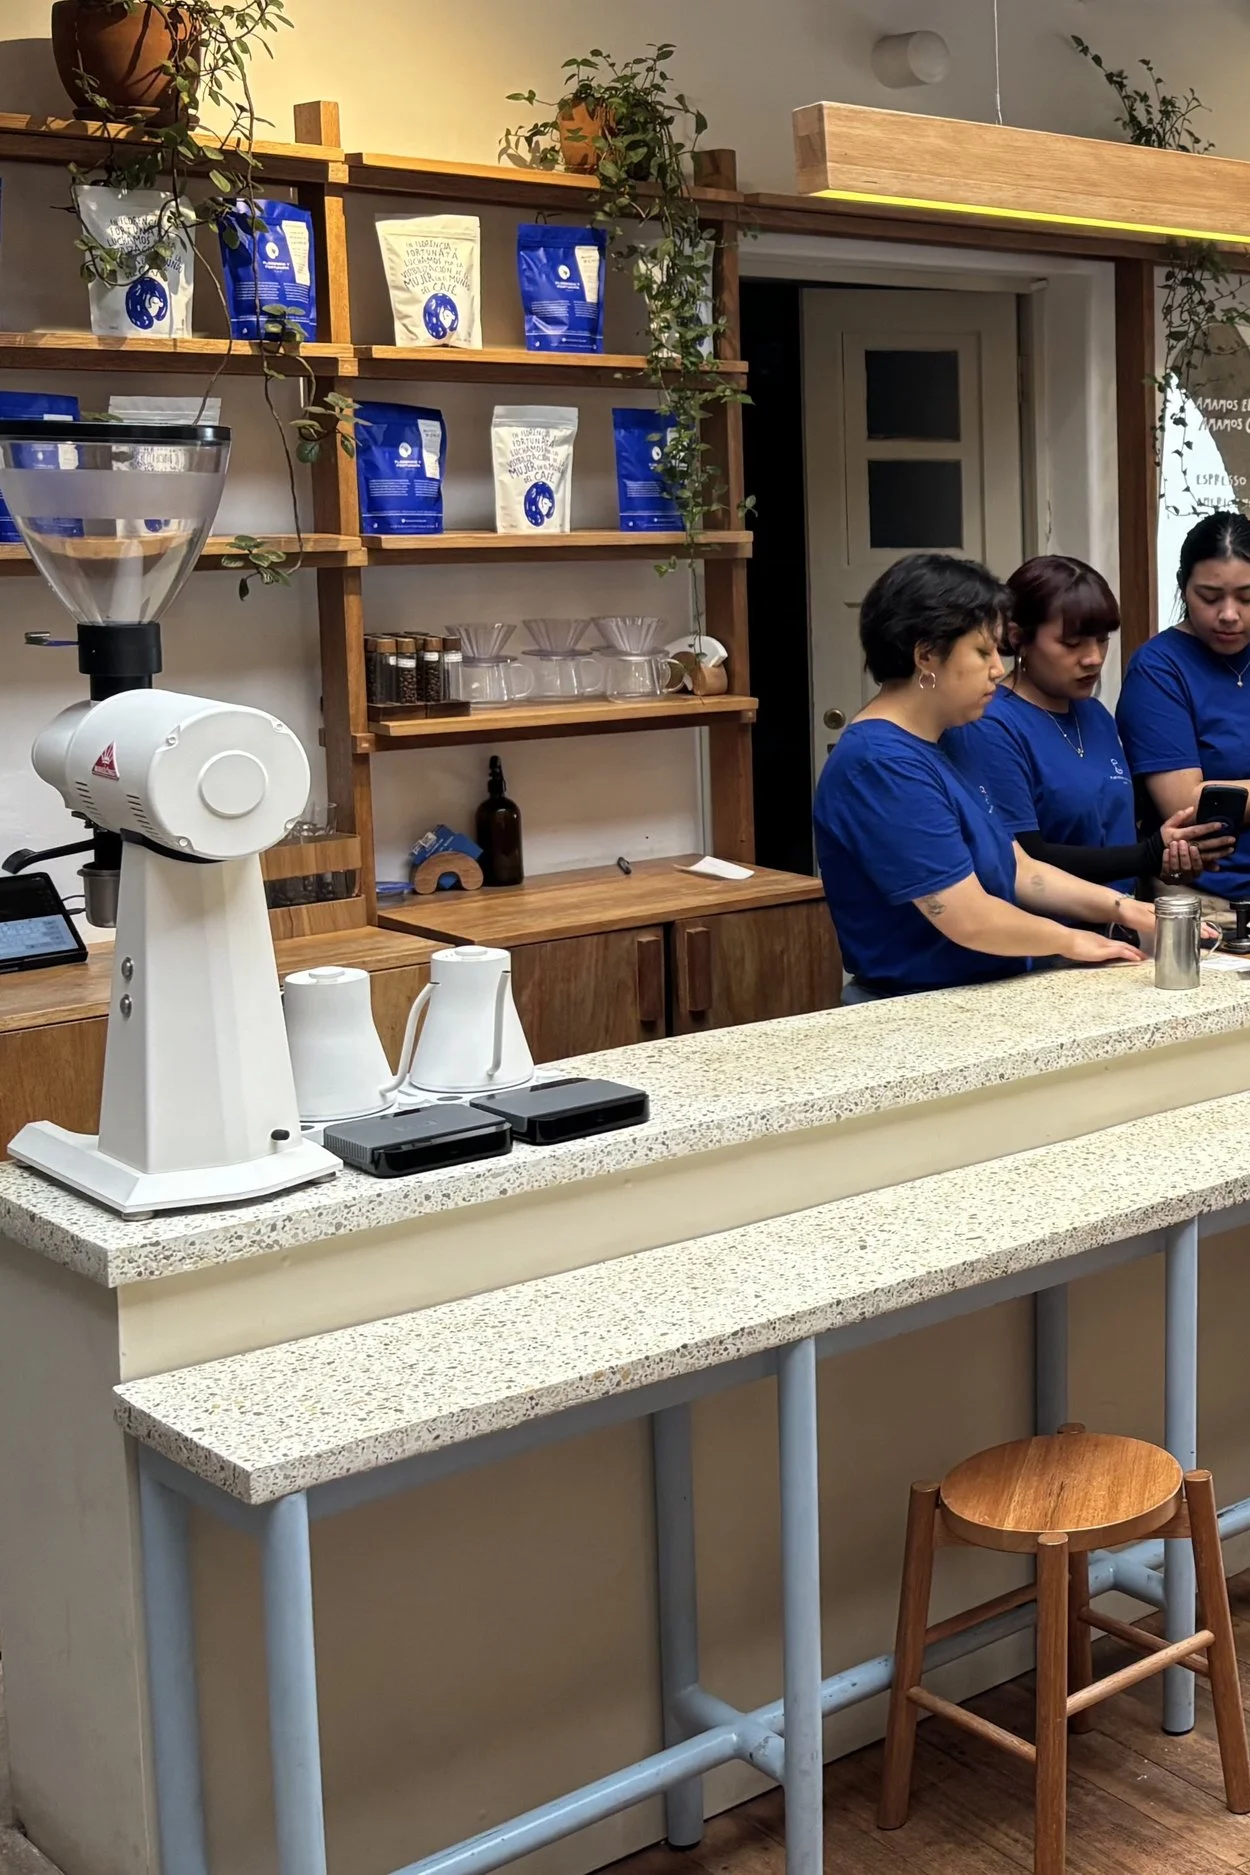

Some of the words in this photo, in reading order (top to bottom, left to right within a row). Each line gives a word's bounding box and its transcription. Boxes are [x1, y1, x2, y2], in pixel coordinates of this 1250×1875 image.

[403, 271, 435, 291] MUJER
[1195, 397, 1238, 412] AMAMOS
[1198, 416, 1243, 432] AMAMOS
[508, 460, 536, 479] MUJER
[1196, 474, 1247, 486] ESPRESSO
